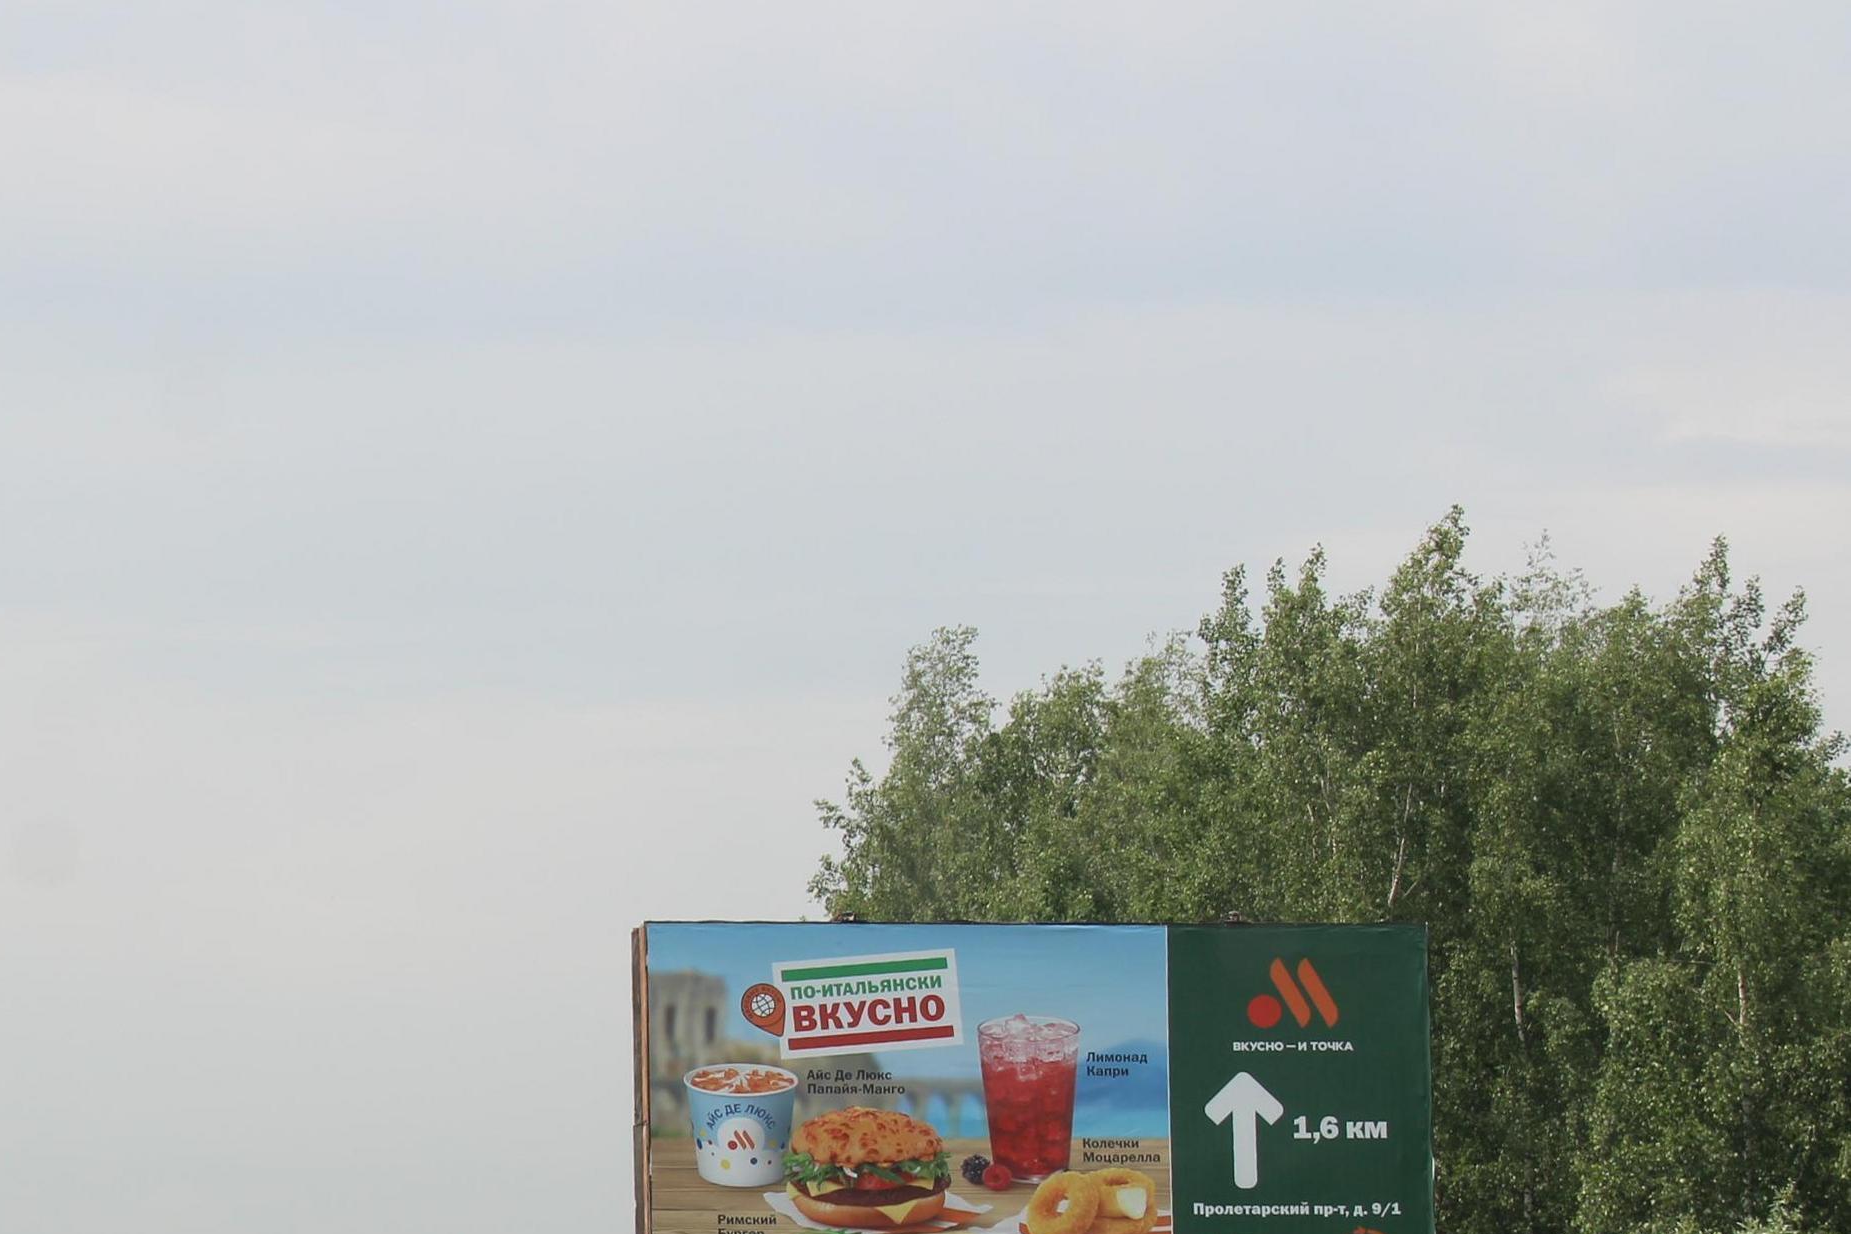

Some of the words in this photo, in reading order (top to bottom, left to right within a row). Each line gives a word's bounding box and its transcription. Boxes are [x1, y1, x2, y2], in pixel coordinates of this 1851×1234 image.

[790, 975, 942, 1000] ПО-ИТАЛЬЯНСКИ
[792, 994, 946, 1032] ВКУСНО
[1232, 1041, 1284, 1052] ВКУСНО
[1298, 1041, 1307, 1051] И
[1310, 1041, 1354, 1052] ТОЧКА
[1086, 1052, 1148, 1064] Лимонад
[807, 1069, 831, 1080] Айс
[834, 1069, 853, 1082] Де
[856, 1069, 893, 1080] Люкс
[1086, 1066, 1129, 1078] Капри
[807, 1083, 906, 1094] Папайя-Манго
[724, 1103, 742, 1116] ДЕ
[744, 1103, 775, 1130] ЛЮКС
[1293, 1115, 1339, 1144] 1,6
[1082, 1137, 1139, 1148] Колечки
[1082, 1151, 1161, 1164] Моцарелла
[1193, 1202, 1309, 1217] Пролетарский
[1314, 1205, 1349, 1217] пр-т,
[1353, 1205, 1367, 1216] д.
[1371, 1202, 1401, 1217] 9/1
[718, 1214, 777, 1225] Римский
